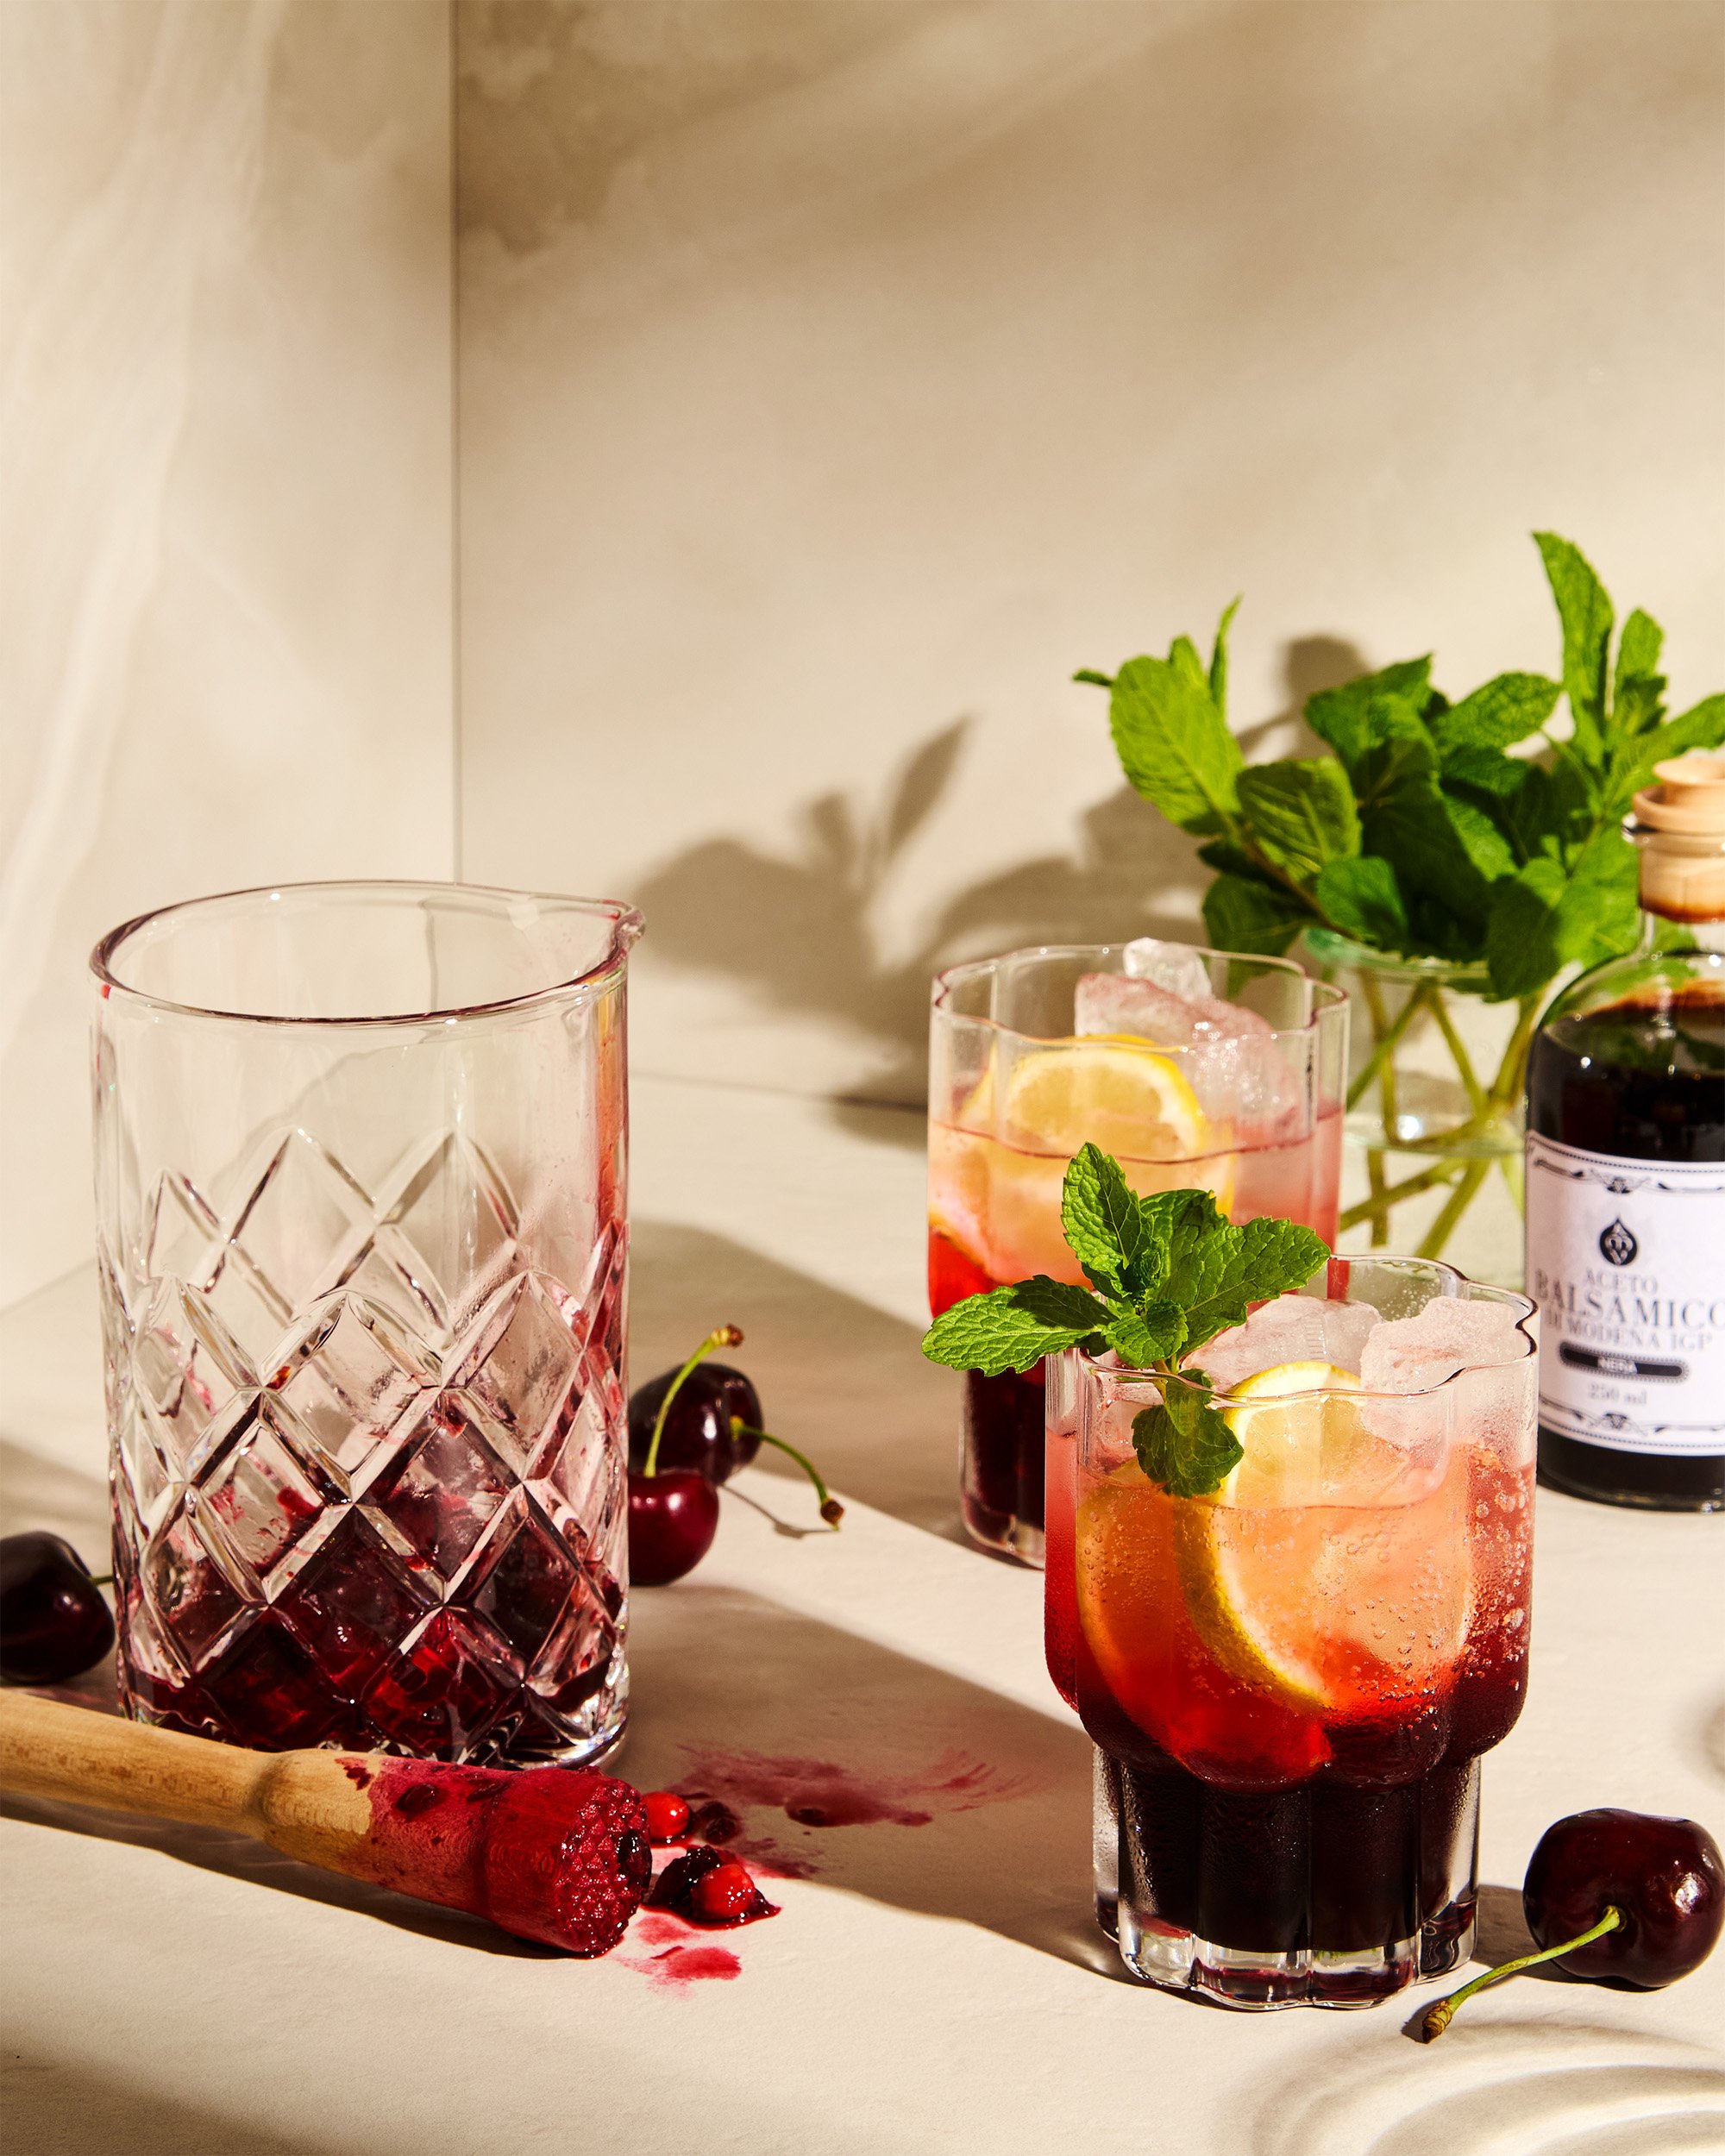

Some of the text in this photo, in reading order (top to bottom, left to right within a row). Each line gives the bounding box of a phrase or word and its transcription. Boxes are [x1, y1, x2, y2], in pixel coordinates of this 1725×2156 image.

[1586, 1269, 1658, 1294] ACETO
[1567, 1316, 1661, 1350] MODENA
[1671, 1332, 1712, 1351] IGP
[1589, 1382, 1647, 1405] 250 ml
